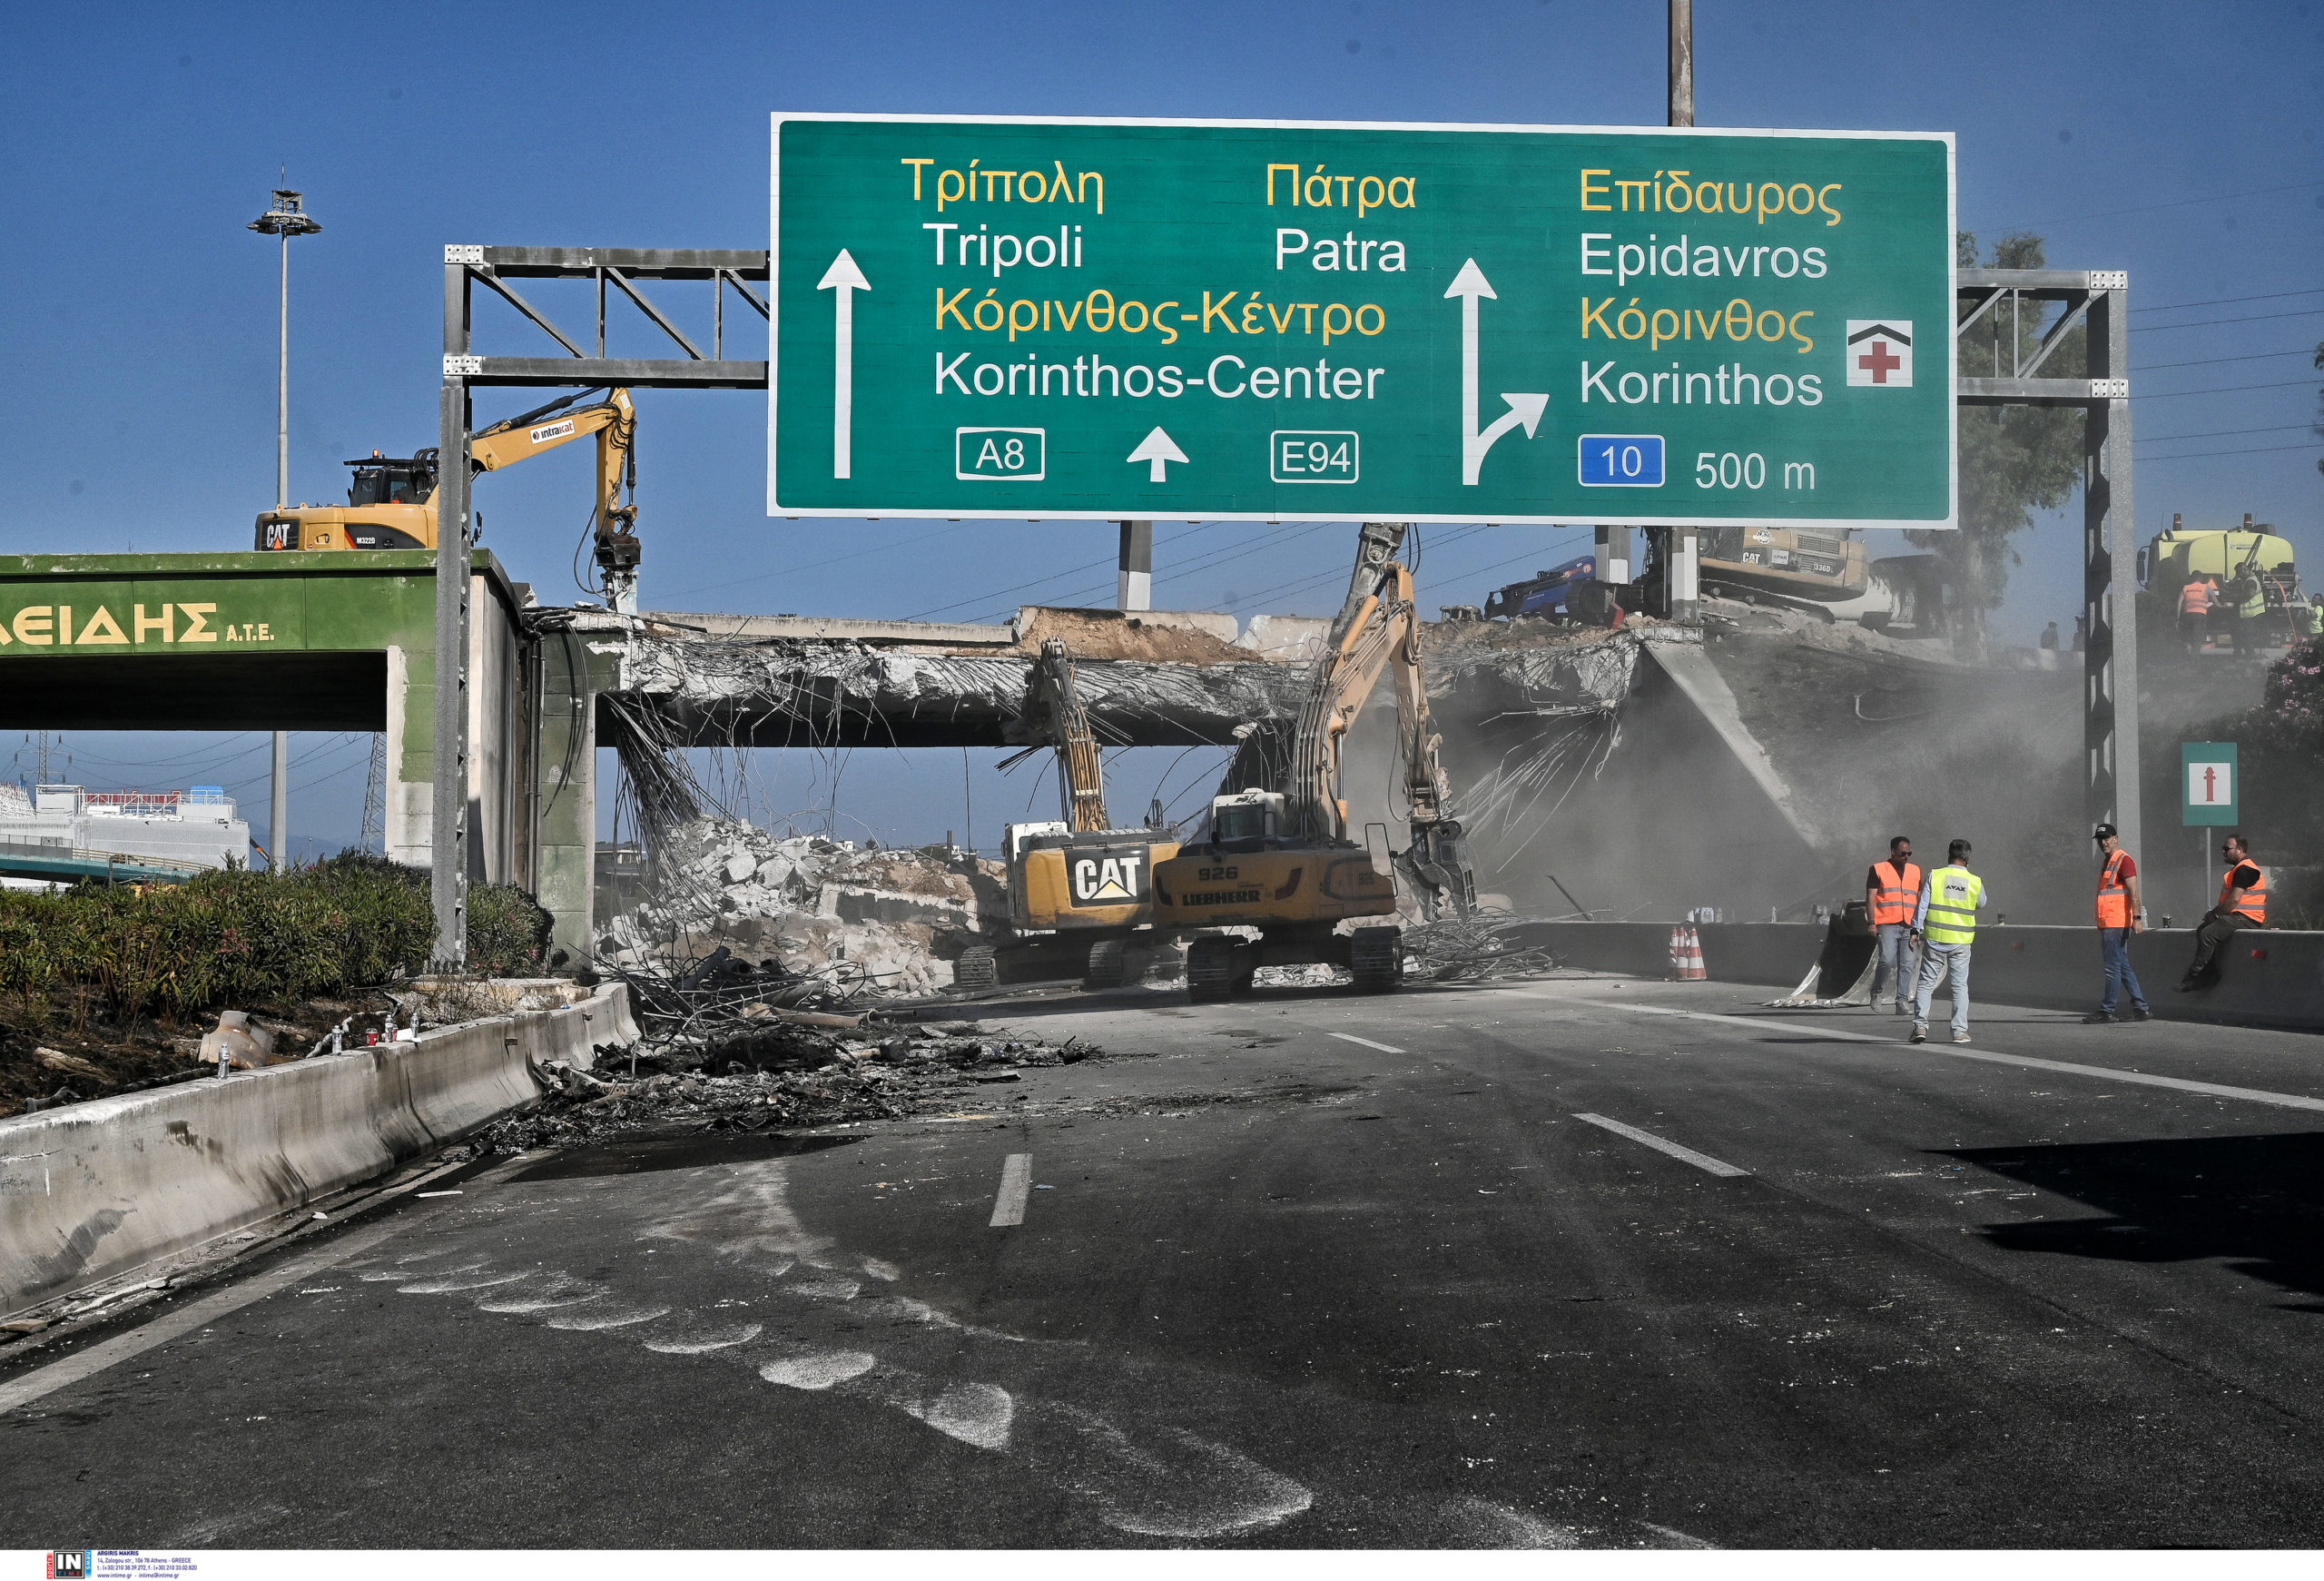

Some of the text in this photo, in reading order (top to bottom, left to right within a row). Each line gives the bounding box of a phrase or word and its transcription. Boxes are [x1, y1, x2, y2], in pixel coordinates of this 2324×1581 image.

[901, 159, 1103, 214] Τρίπολη
[1267, 163, 1416, 218] Πάτρα
[1581, 169, 1843, 226] Επίδαυρος
[922, 223, 1082, 277] Tripoli
[1276, 229, 1406, 272] Patra
[1581, 233, 1827, 285] Epidavros
[936, 288, 1385, 345] Κόρινθος-Κέντρο
[1581, 297, 1814, 353] Κόρινθος
[936, 352, 1385, 399] Korinthos-Center
[1581, 361, 1823, 406] Korinthos
[976, 438, 1025, 469] A8
[1282, 441, 1351, 473] E94
[1601, 446, 1641, 476] 10
[1695, 453, 1815, 489] 500 m
[266, 524, 290, 548] CAT
[1743, 551, 1760, 565] CAT
[1075, 857, 1141, 900] CAT
[1197, 866, 1238, 881] 926
